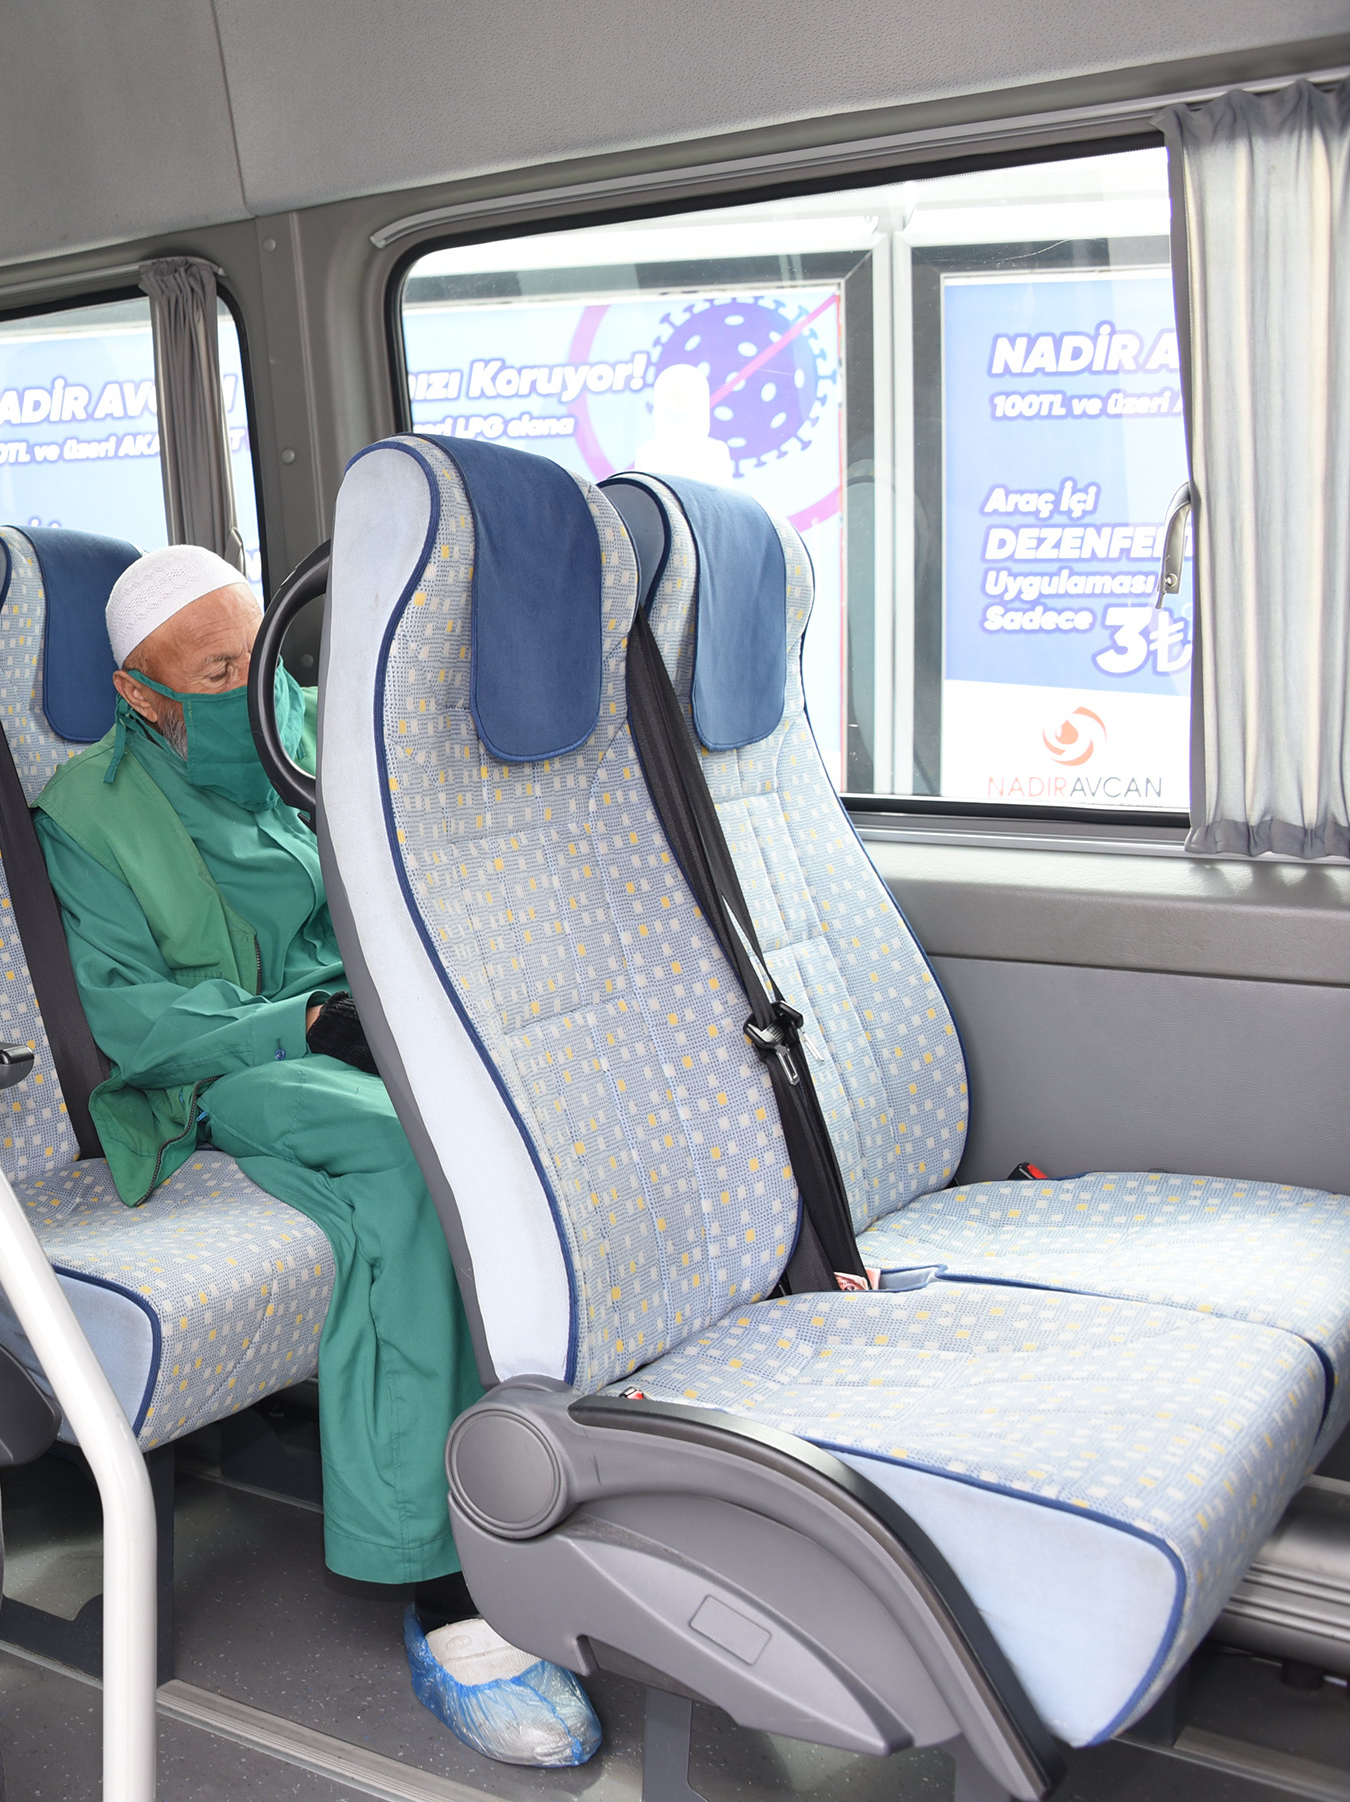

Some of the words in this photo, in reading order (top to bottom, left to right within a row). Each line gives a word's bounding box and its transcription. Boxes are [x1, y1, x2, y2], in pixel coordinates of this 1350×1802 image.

[991, 324, 1141, 374] NADİR
[468, 353, 648, 402] Koruyor!
[994, 394, 1066, 417] 100TL
[1072, 399, 1102, 416] ve
[1107, 391, 1171, 414] üzeri
[455, 416, 505, 438] LPG
[34, 444, 61, 462] ve
[63, 436, 117, 460] üzeri
[984, 487, 1055, 518] Araç
[1060, 480, 1097, 518] İçi
[985, 569, 1155, 601] Uygulaması
[983, 605, 1093, 631] Sadece
